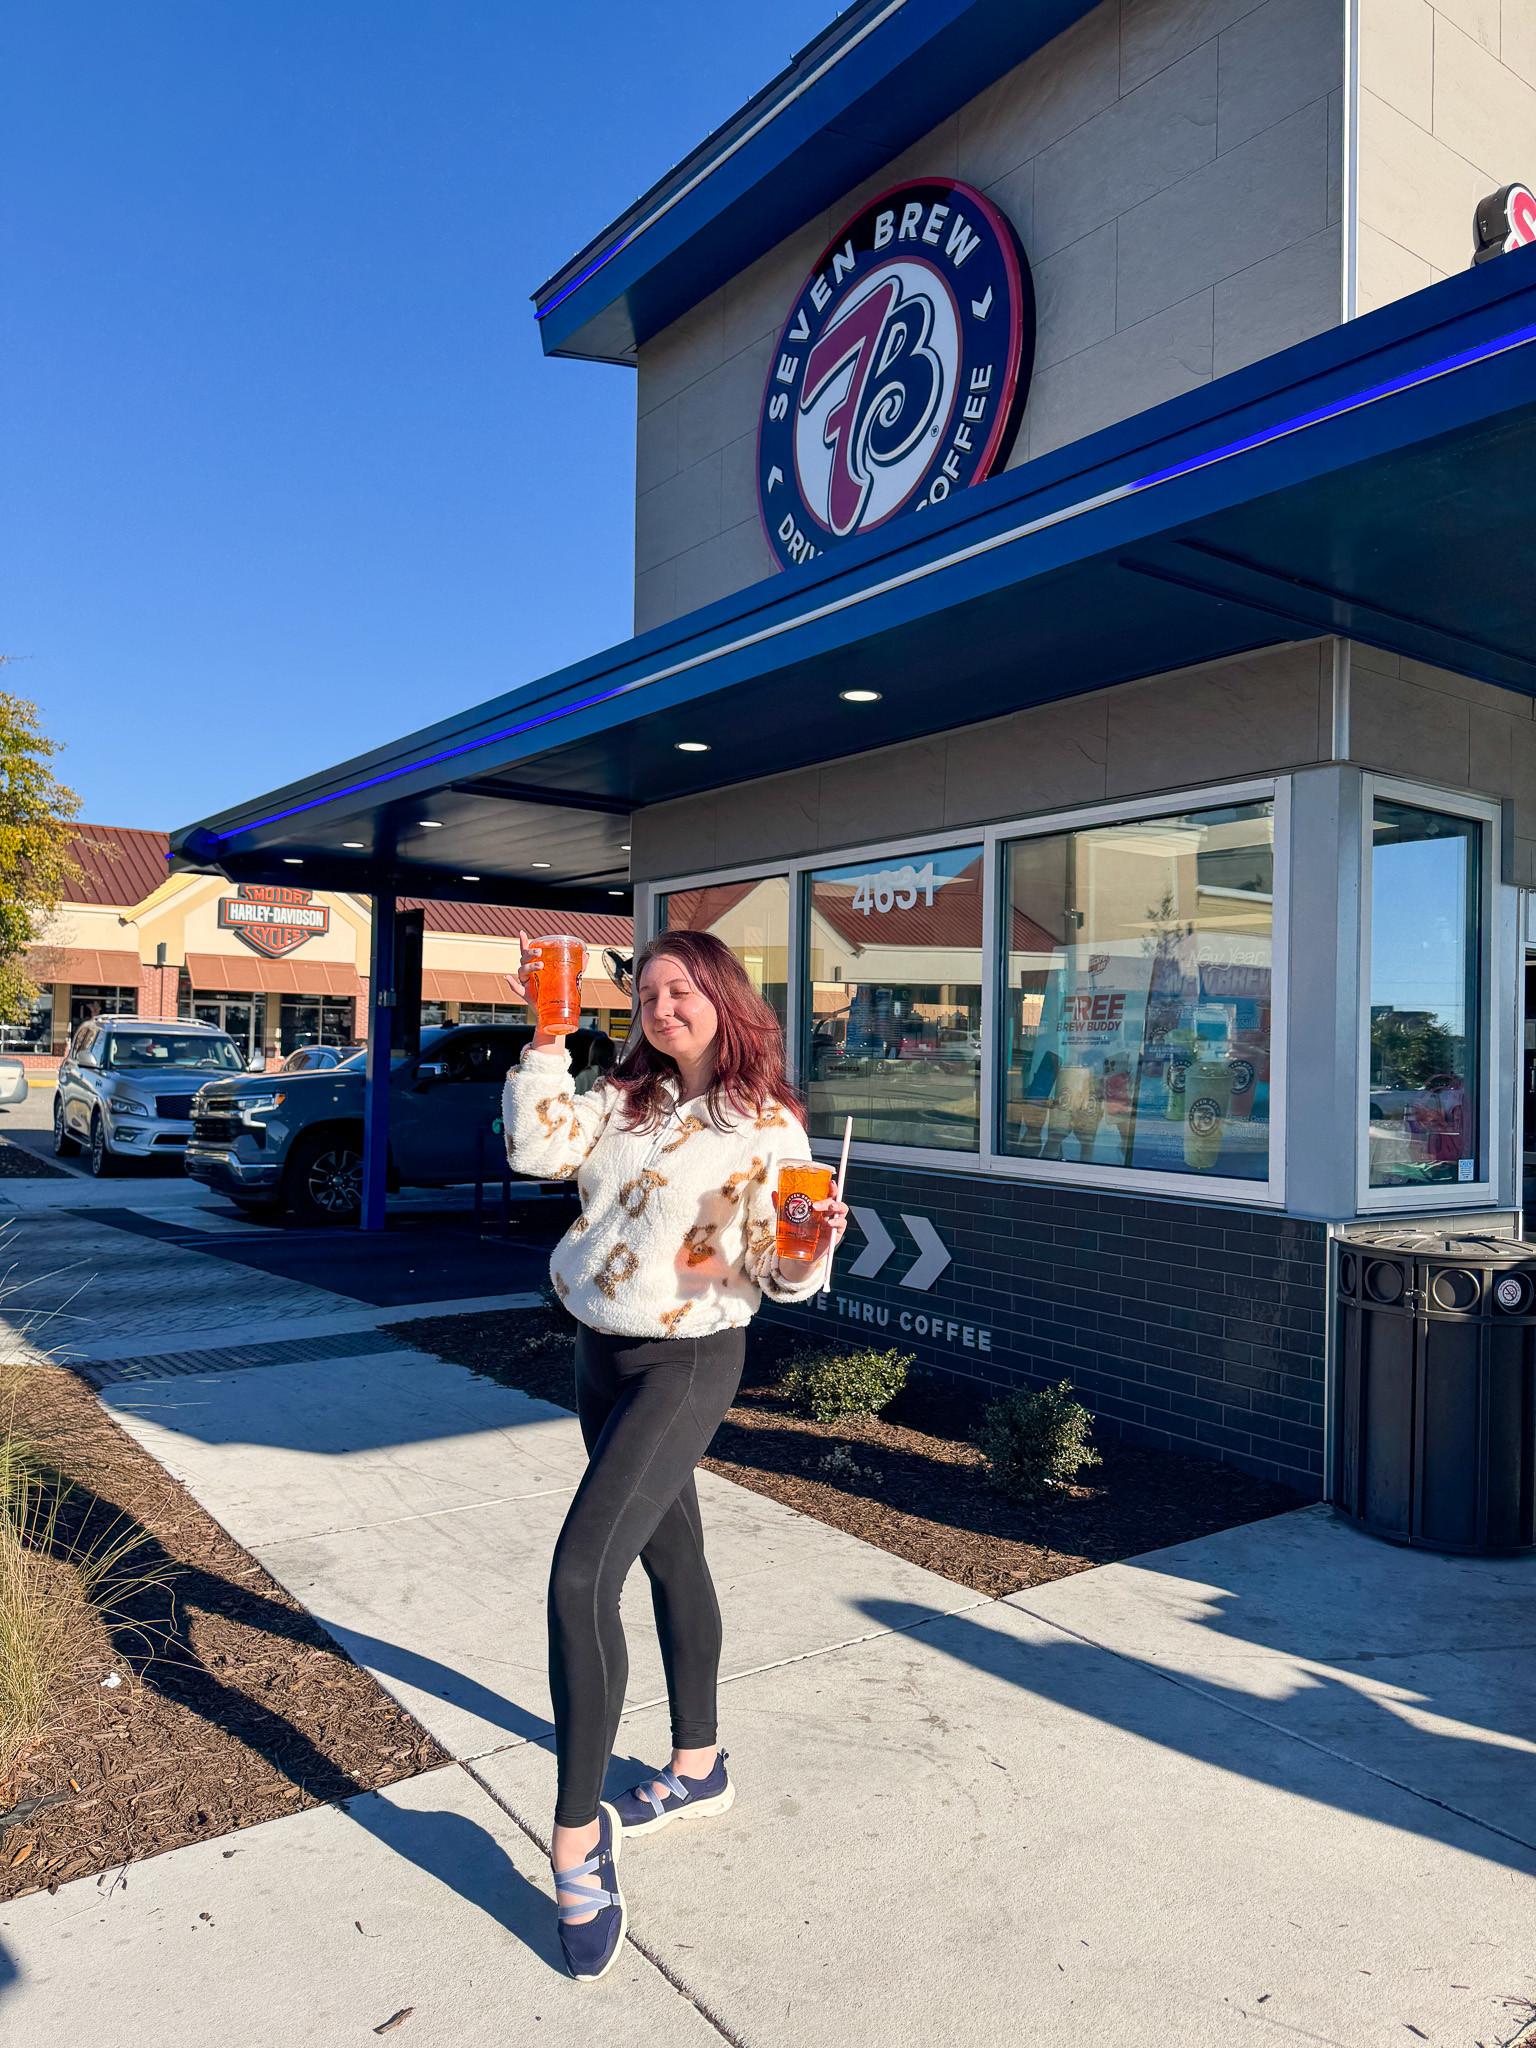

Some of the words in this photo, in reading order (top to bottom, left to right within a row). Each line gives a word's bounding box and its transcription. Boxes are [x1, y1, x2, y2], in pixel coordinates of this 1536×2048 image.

[768, 239, 858, 422] SEVEN
[873, 202, 981, 268] BREW
[253, 887, 304, 905] MOTOR
[852, 862, 933, 916] 4631
[229, 902, 324, 927] HARLEY-DAVIDSON
[251, 926, 302, 949] CYCLES
[1063, 993, 1126, 1021] FREE
[1056, 1021, 1085, 1032] BREW
[1087, 1021, 1122, 1032] BUDDY
[836, 1295, 890, 1327] THRU
[900, 1311, 993, 1352] COFFEE
